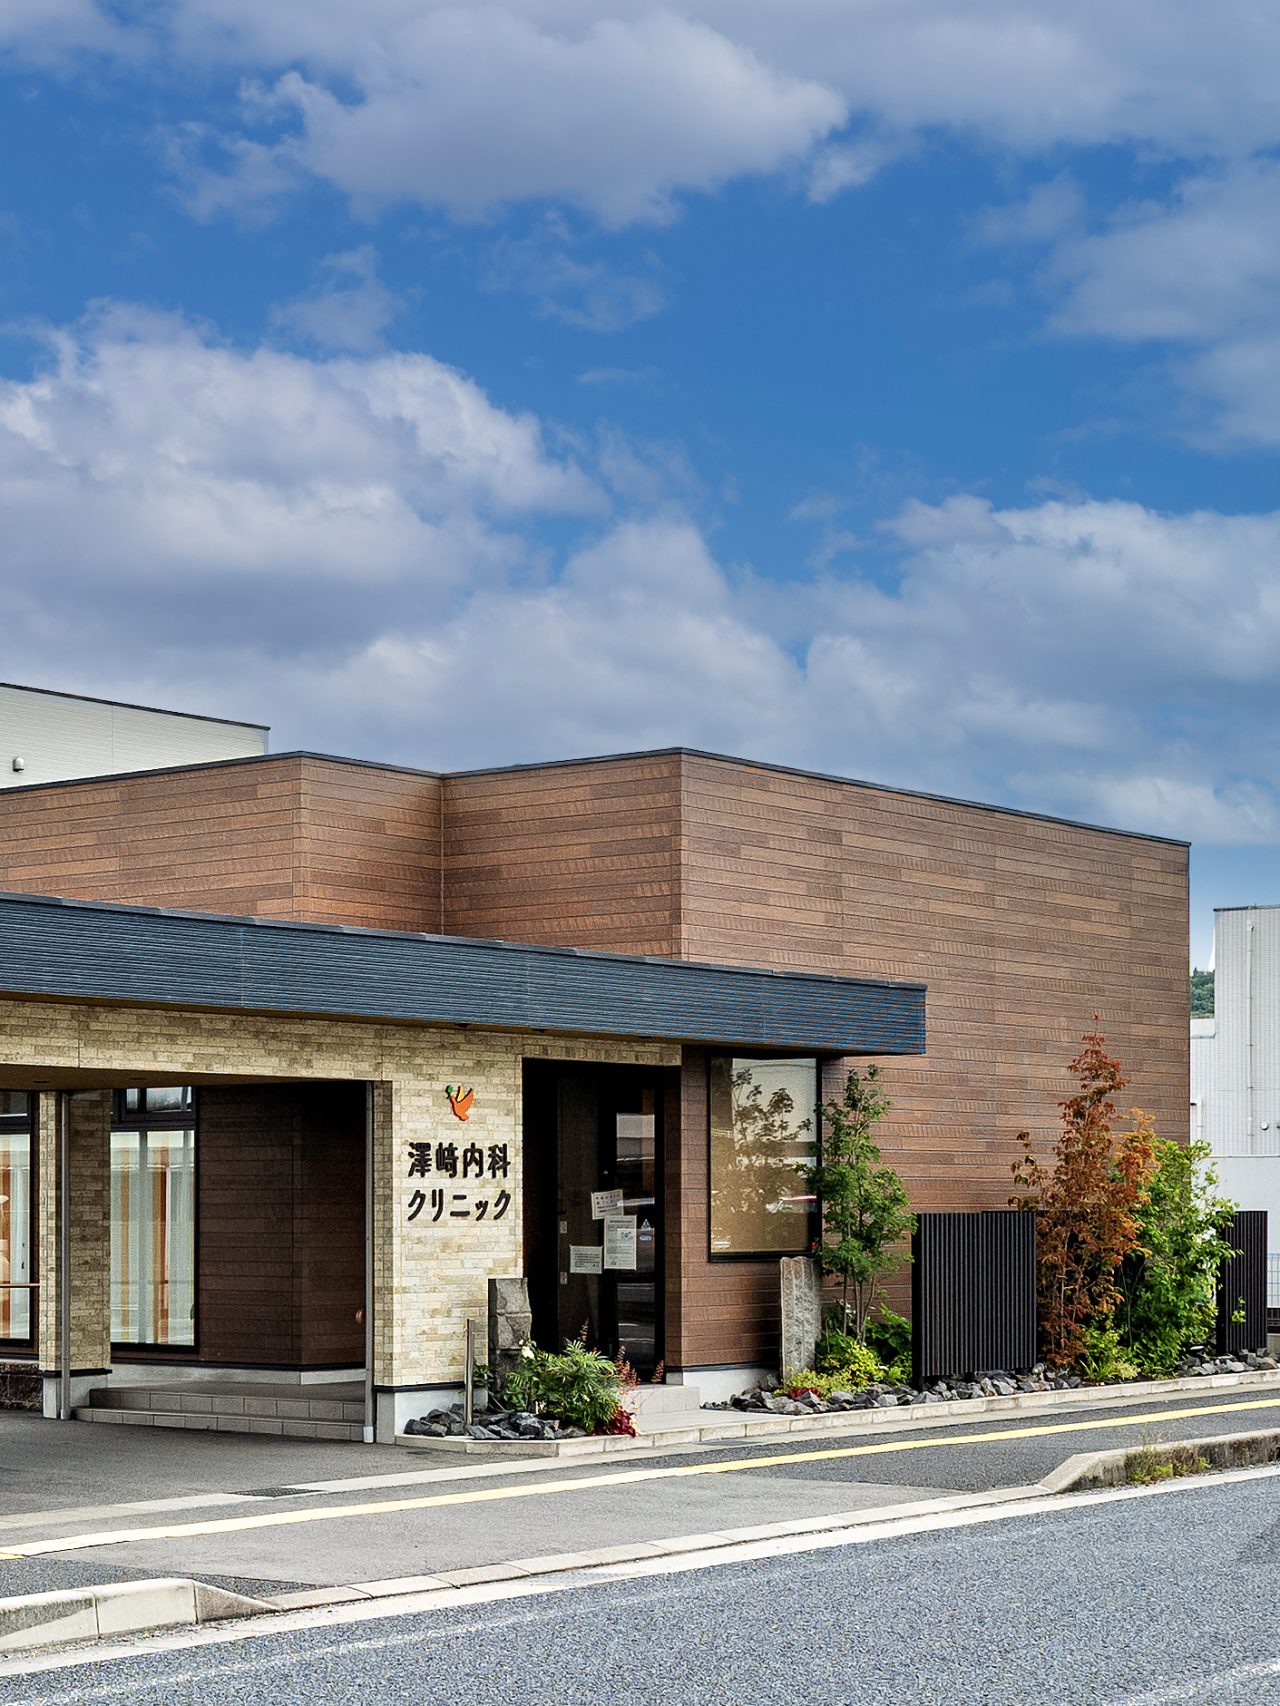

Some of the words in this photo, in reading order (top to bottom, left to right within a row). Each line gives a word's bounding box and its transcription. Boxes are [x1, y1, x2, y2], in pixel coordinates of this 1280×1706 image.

[407, 1188, 512, 1222] クリニック
